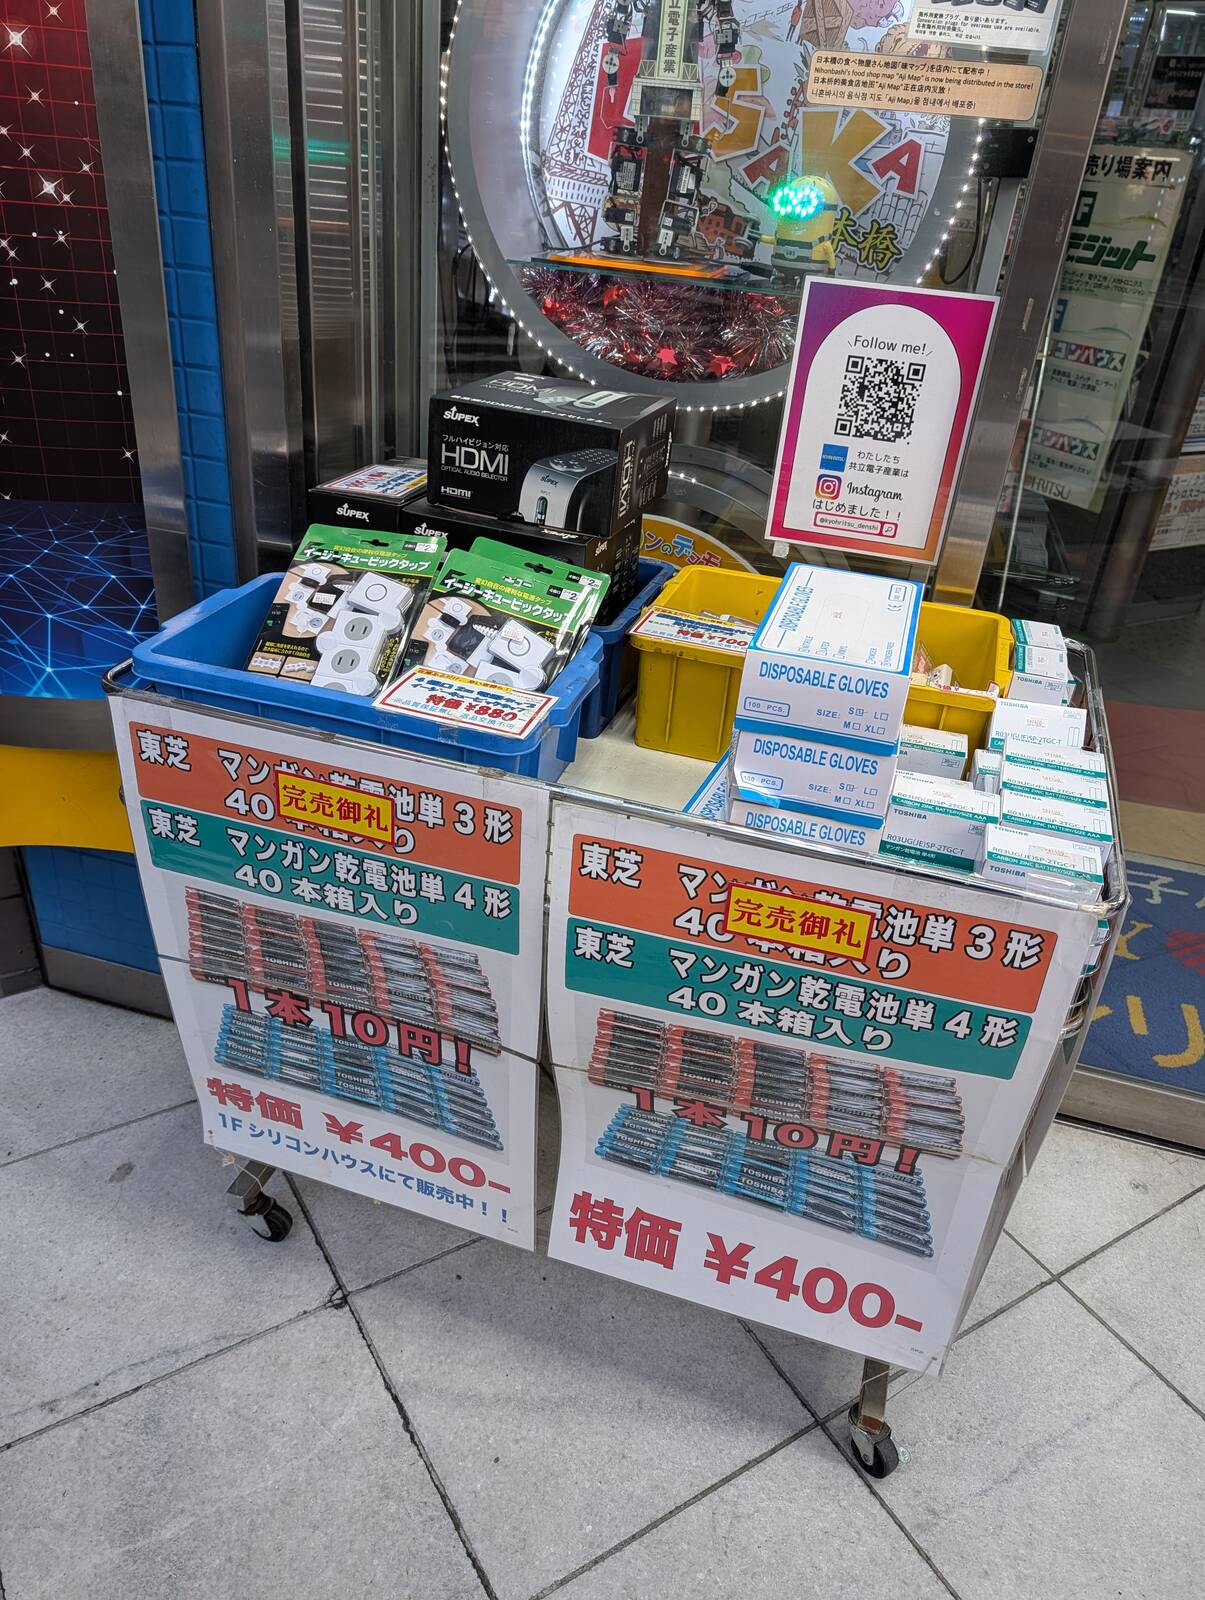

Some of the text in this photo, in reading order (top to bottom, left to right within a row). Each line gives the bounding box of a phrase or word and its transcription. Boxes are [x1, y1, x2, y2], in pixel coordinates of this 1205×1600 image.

[852, 69, 865, 77] food
[866, 71, 880, 80] shop
[945, 77, 962, 86] being
[962, 78, 996, 88] distributed
[1004, 81, 1014, 89] the
[1085, 154, 1173, 182] 売り場案内
[852, 334, 927, 356] Follow me!
[443, 406, 480, 427] SUPEX
[442, 434, 510, 453] フルハイビジョン対応
[441, 443, 509, 476] HDMI
[856, 450, 901, 465] わたしたち
[440, 465, 508, 482] OPTICAL AUDIO SELECTOR
[848, 461, 910, 478] 共立電子産業は
[440, 485, 472, 498] HDMI
[846, 481, 904, 502] Instagram
[336, 502, 370, 523] SUPEX
[812, 498, 901, 521] はじめました！！
[413, 522, 449, 540] SUPEX
[819, 516, 879, 532] @kyohritsu_denshi
[303, 547, 432, 572] イージーキュービックタップ
[758, 660, 890, 700] DISPOSABLE GLOVES
[1016, 676, 1043, 685] TOSHIBA
[424, 693, 465, 711] 特価
[747, 701, 880, 721] 100 PCS. SIZE: S L
[1000, 700, 1029, 710] TOSHIBA
[843, 720, 876, 735] M XL
[136, 729, 192, 772] 東芝
[753, 738, 879, 776] DISPOSABLE GLOVES
[808, 783, 832, 795] SIZE:
[839, 781, 846, 791] S
[863, 785, 870, 795] L
[281, 784, 389, 833] 完売御礼
[834, 794, 867, 809] M XL
[893, 808, 928, 821] TOSHIBA
[148, 807, 202, 848] 東芝
[745, 811, 867, 847] DISPOSABLE GLOVES
[886, 833, 966, 856] R03UG(JE)SP-2TGC-T
[578, 842, 644, 890] 東芝
[989, 865, 1027, 878] TOSHIBA
[731, 898, 863, 950] 完売御礼
[573, 926, 635, 970] 東芝
[264, 957, 308, 970] TOSHIBA
[227, 1041, 263, 1056] TOSHIBA
[336, 1071, 375, 1087] TOSHIBA
[338, 1080, 378, 1096] TOSHIBA
[683, 1072, 730, 1087] TOSHIBA
[205, 1075, 513, 1195] 特価 ¥400-
[614, 1133, 657, 1150] TOSHIBA
[742, 1166, 787, 1187] TOSHIBA
[740, 1176, 785, 1198] TOSHIBA
[568, 1190, 925, 1335] 特価 ¥400-
